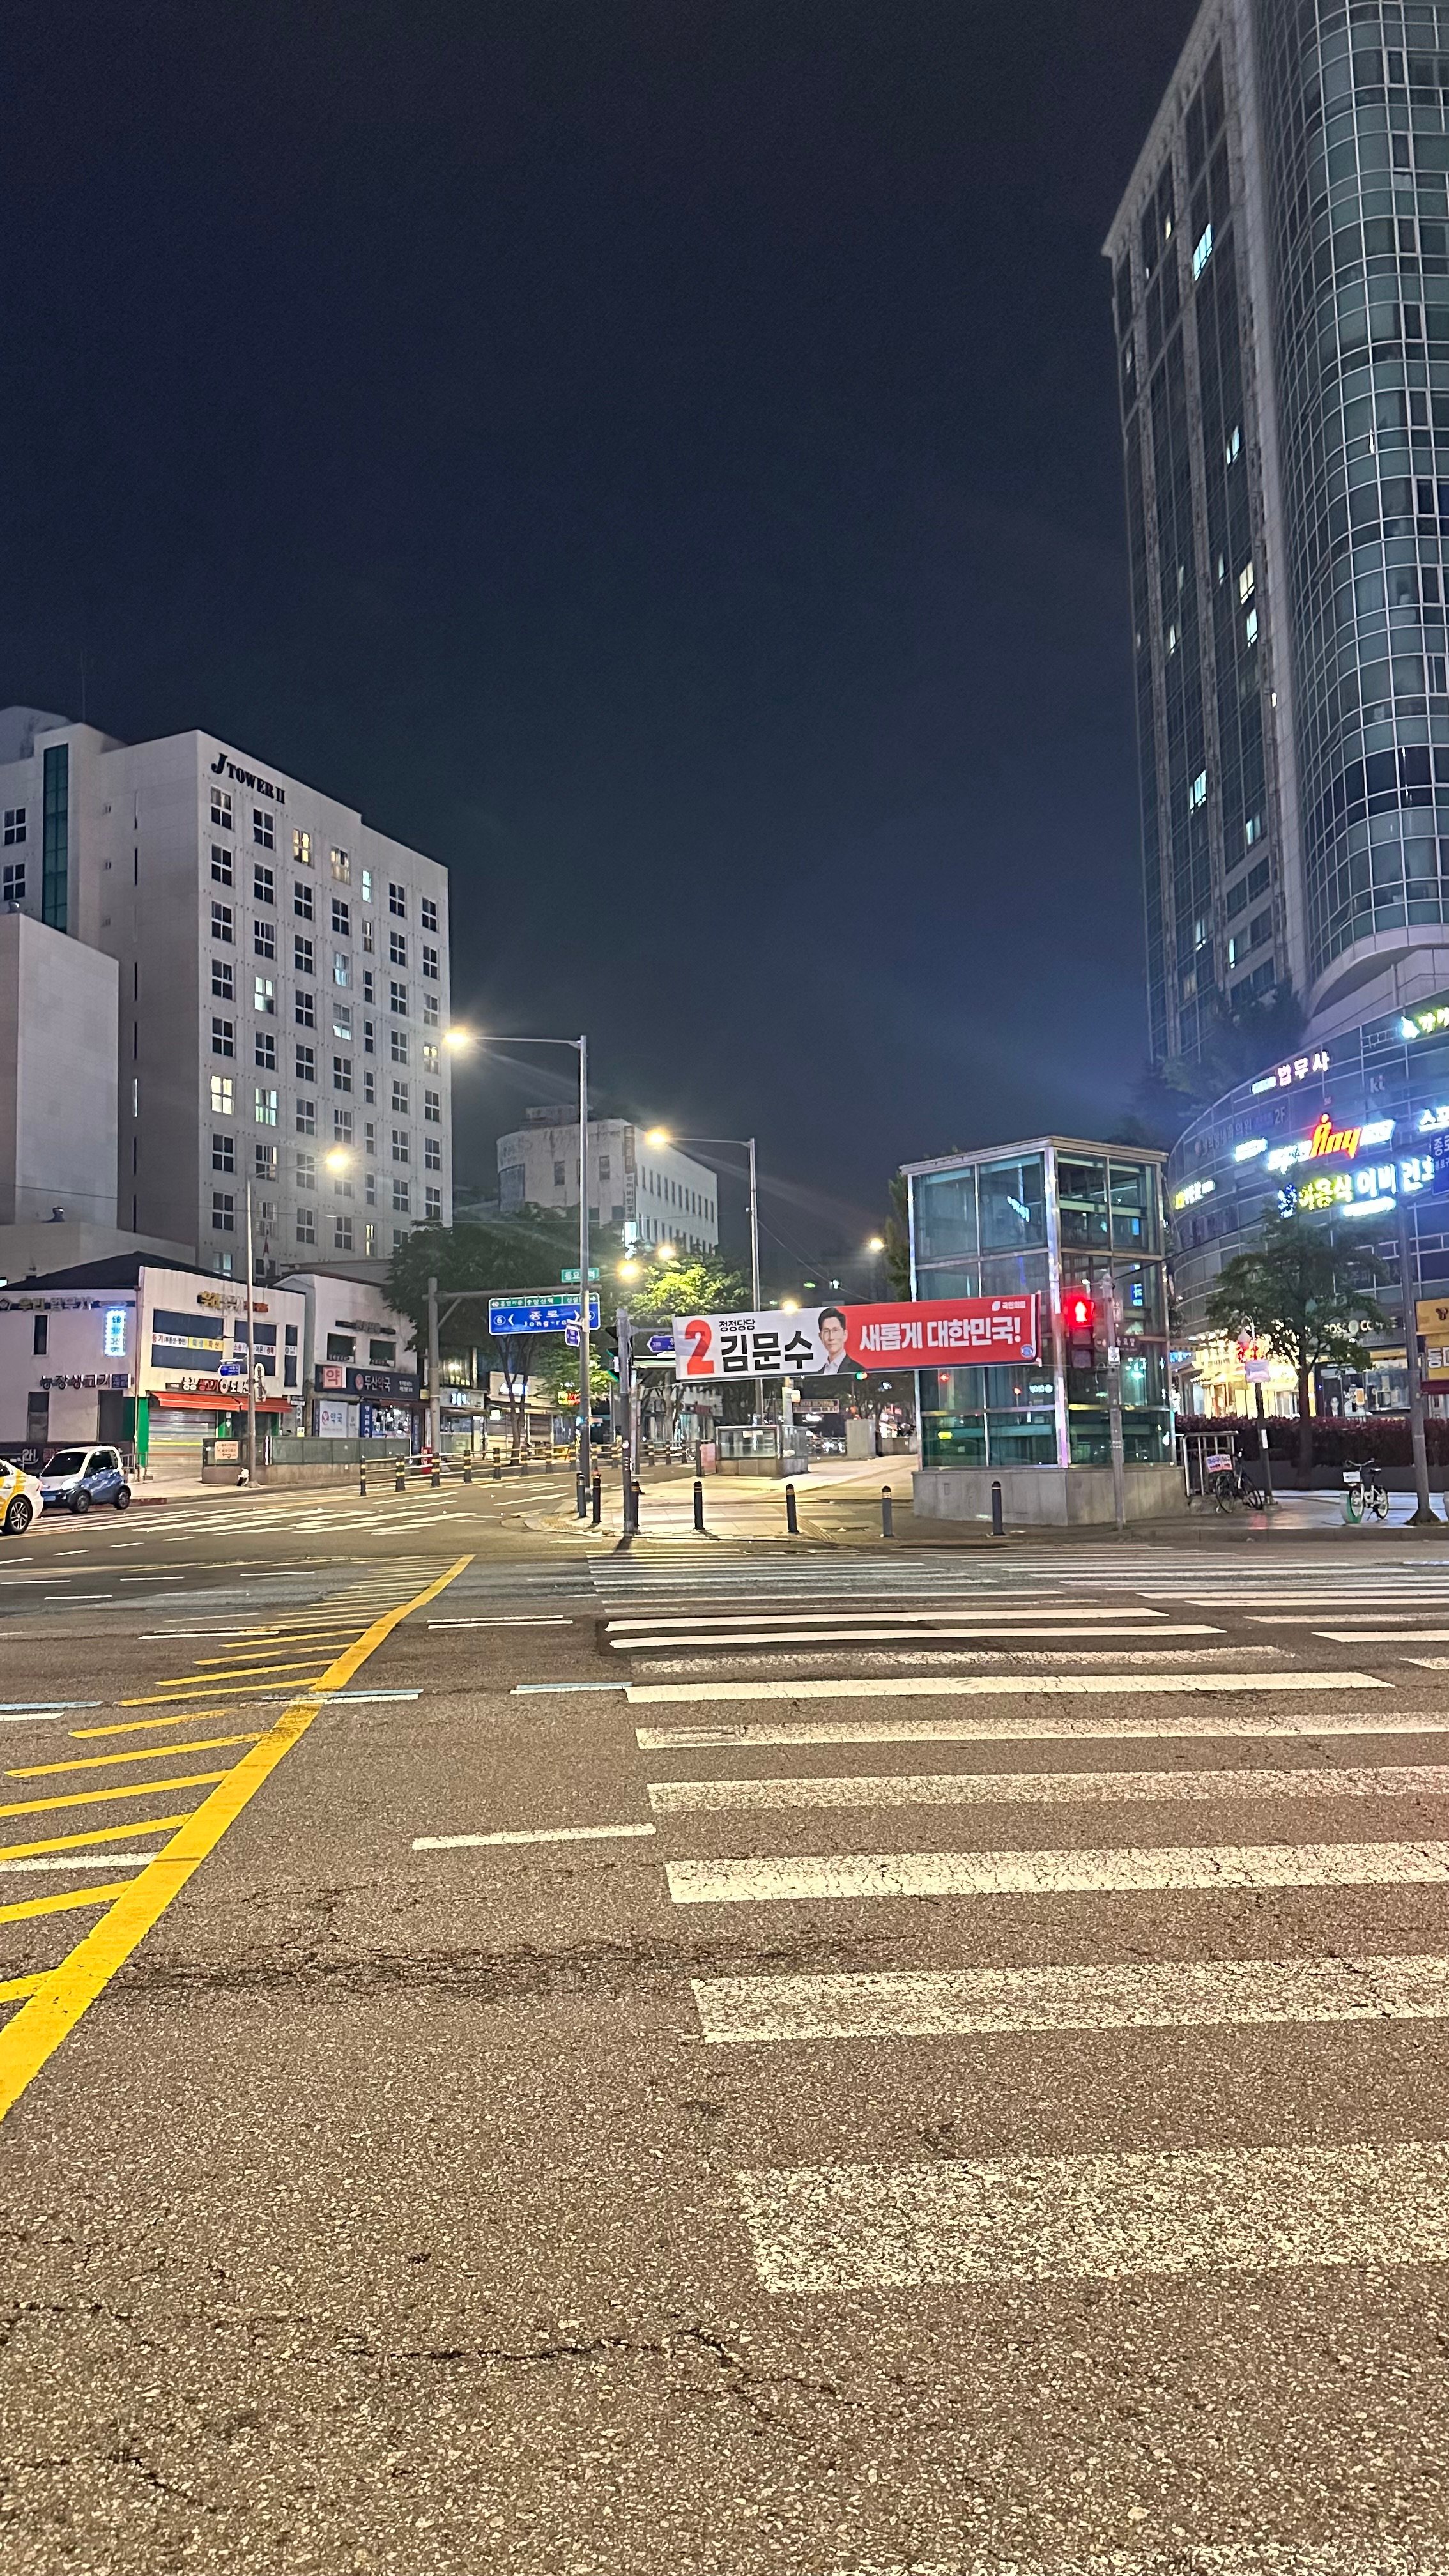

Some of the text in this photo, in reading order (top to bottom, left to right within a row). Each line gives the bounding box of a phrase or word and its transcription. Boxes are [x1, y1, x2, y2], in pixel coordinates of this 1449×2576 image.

[227, 762, 274, 799] TOWER
[1278, 1050, 1330, 1087] 법무사
[564, 1270, 595, 1280] 동묘역
[719, 1319, 755, 1332] 정정당당
[859, 1316, 1021, 1351] 새롭게 대한민국!
[685, 1319, 714, 1375] 2
[720, 1330, 813, 1373] 김문수
[326, 1370, 340, 1386] 약
[364, 1375, 391, 1392] 두산약국
